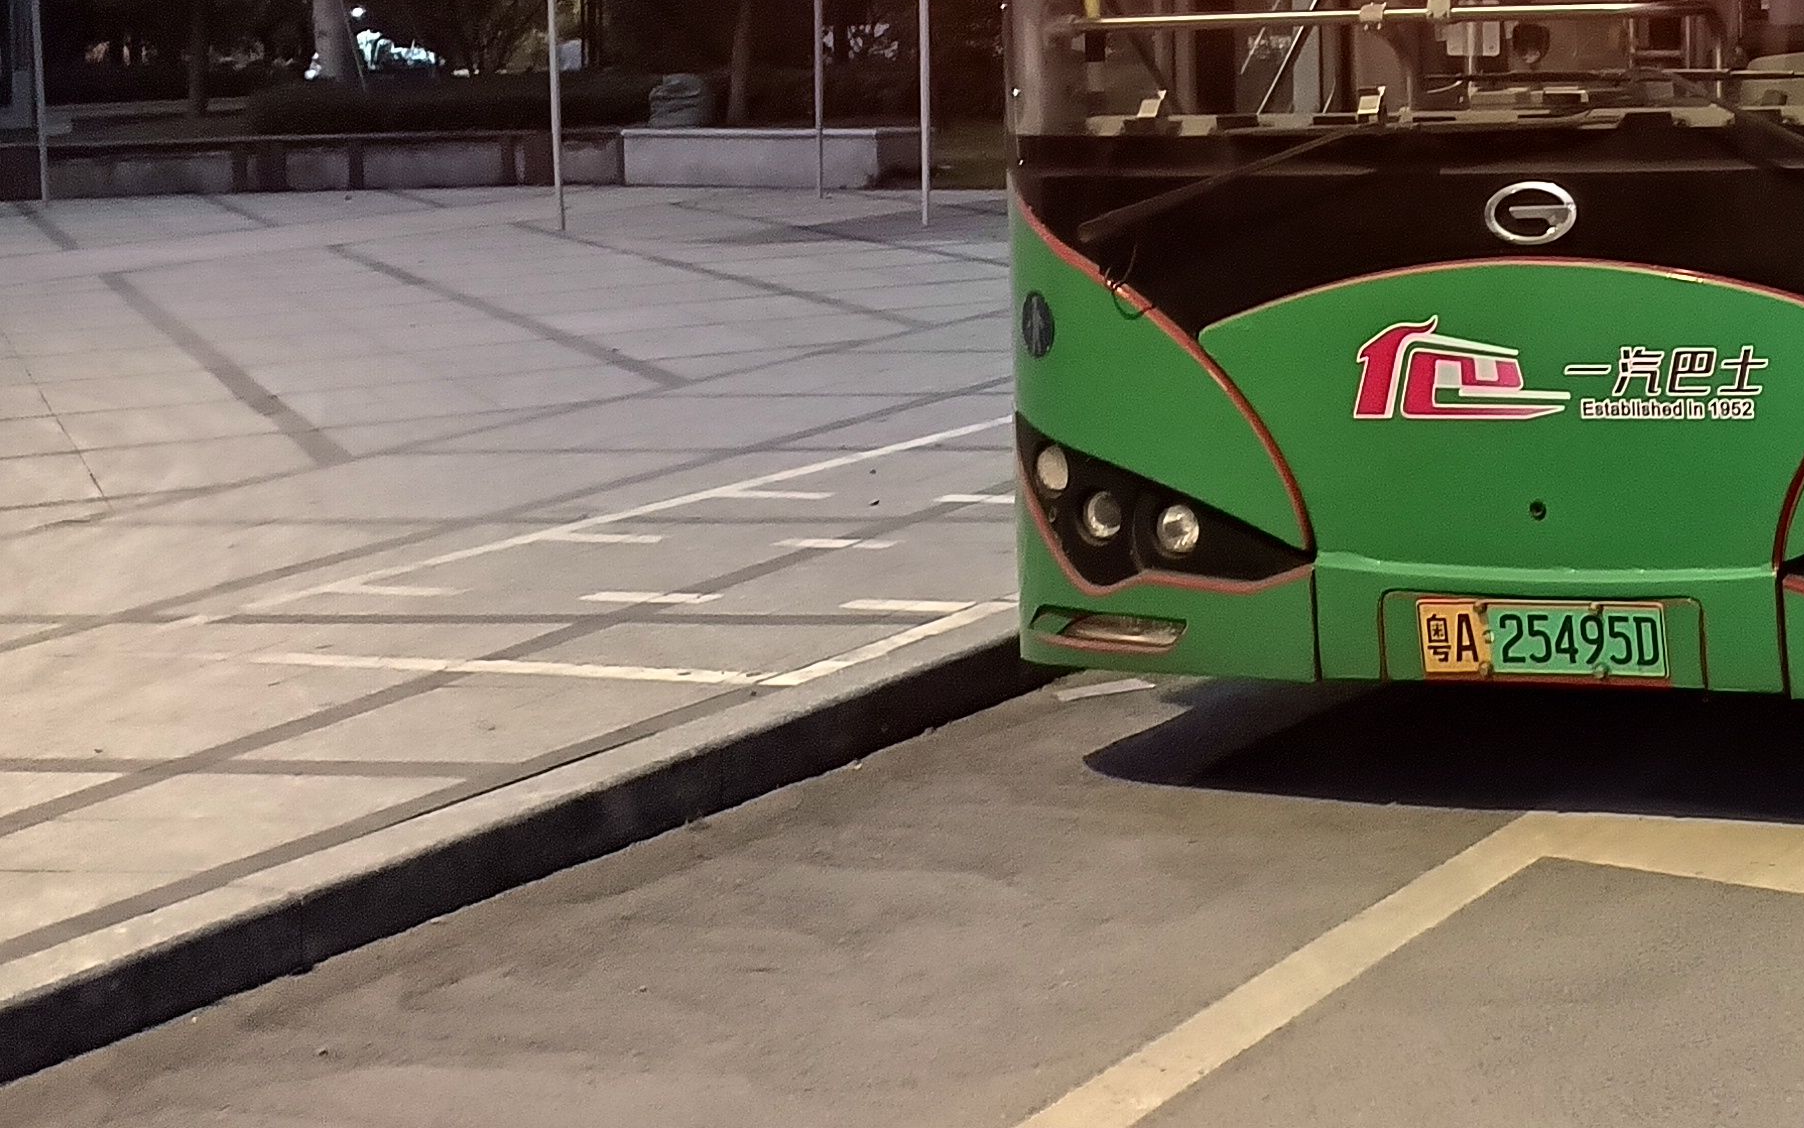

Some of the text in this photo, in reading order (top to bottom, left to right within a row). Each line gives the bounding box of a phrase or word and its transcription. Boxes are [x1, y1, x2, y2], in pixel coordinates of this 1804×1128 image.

[1566, 346, 1768, 396] 一汽巴士
[1582, 399, 1683, 418] Established
[1709, 399, 1754, 418] 1952
[1499, 614, 1660, 665] 25495D
